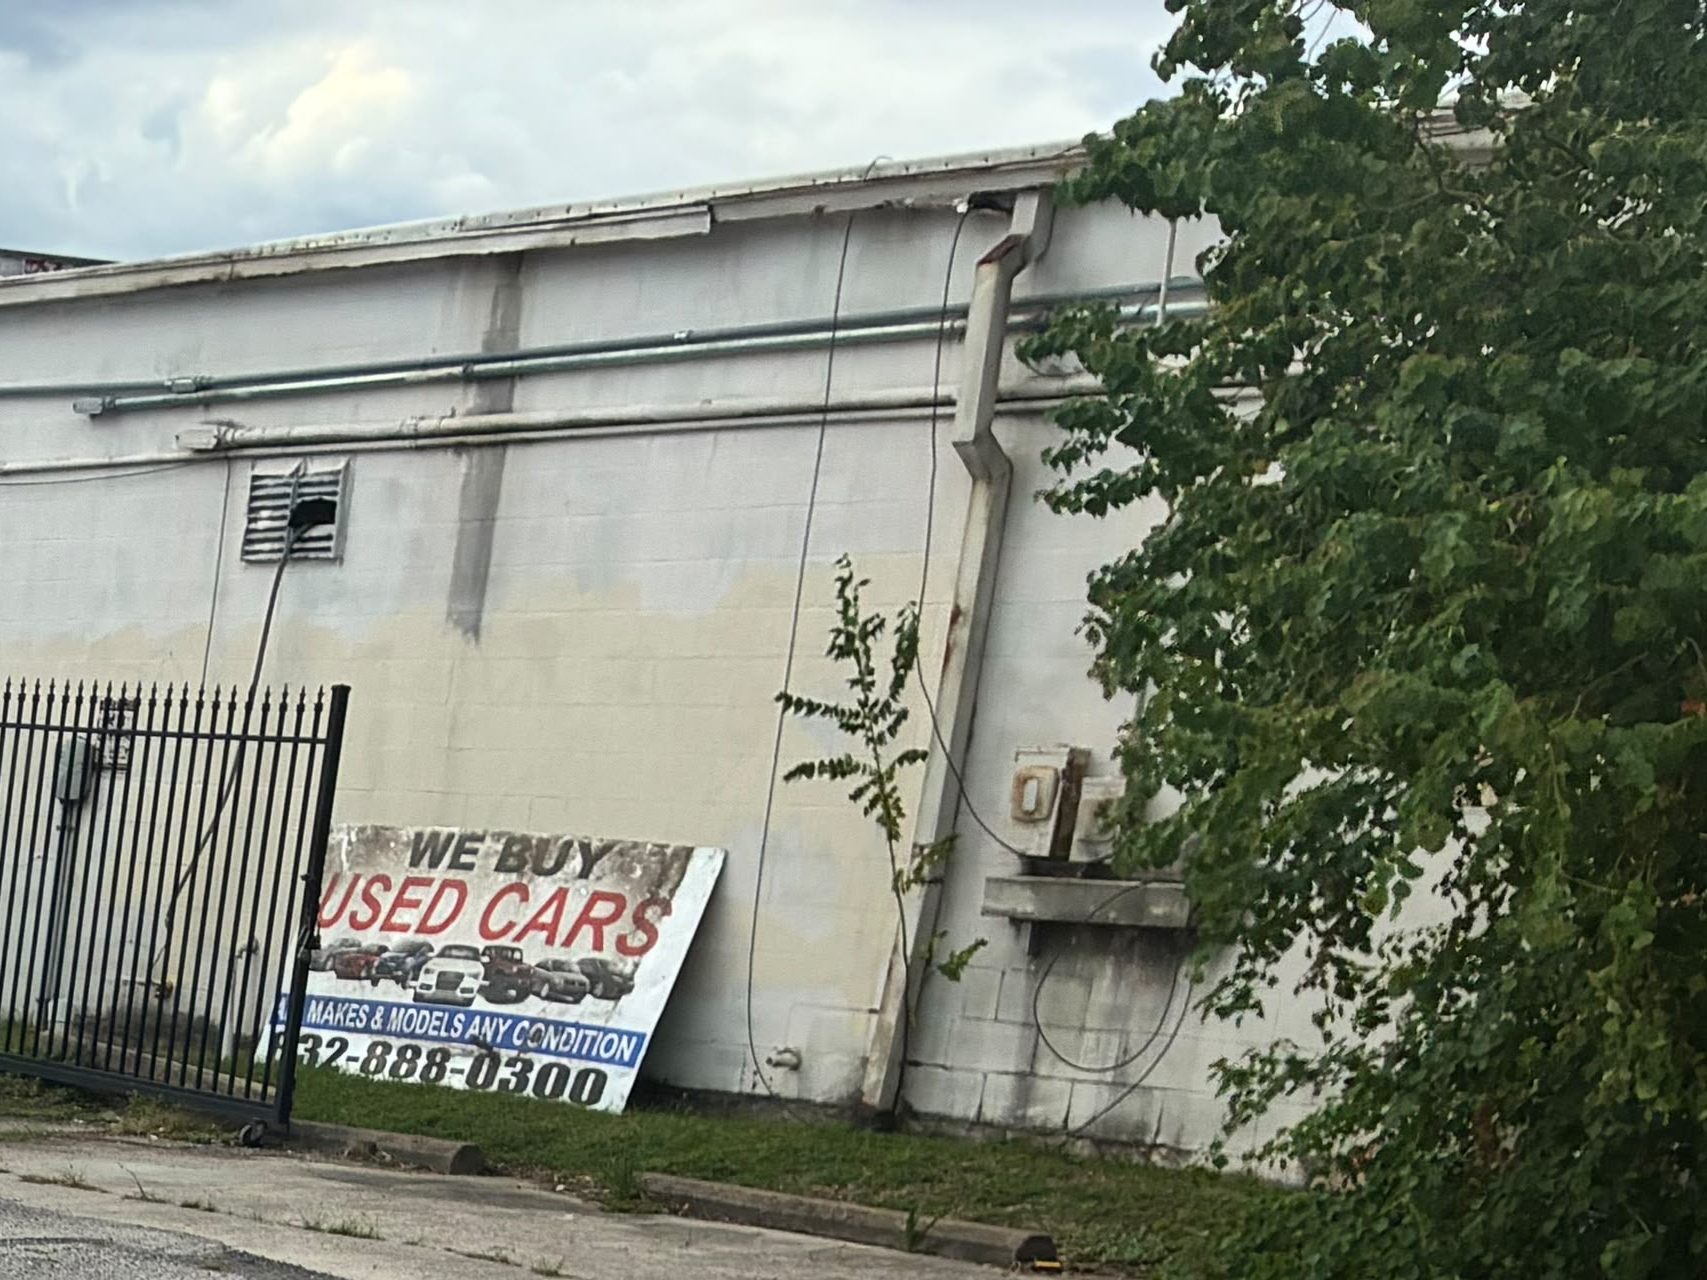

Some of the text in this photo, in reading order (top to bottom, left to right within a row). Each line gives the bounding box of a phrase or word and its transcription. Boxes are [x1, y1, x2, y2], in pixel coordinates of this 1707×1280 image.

[408, 831, 620, 879] WE BUY
[318, 873, 673, 957] USED CARS
[306, 999, 370, 1029] MAKES
[370, 1005, 385, 1031] &
[387, 1006, 466, 1038] MODELS
[464, 1015, 513, 1044] ANY
[512, 1019, 636, 1062] CONDITION
